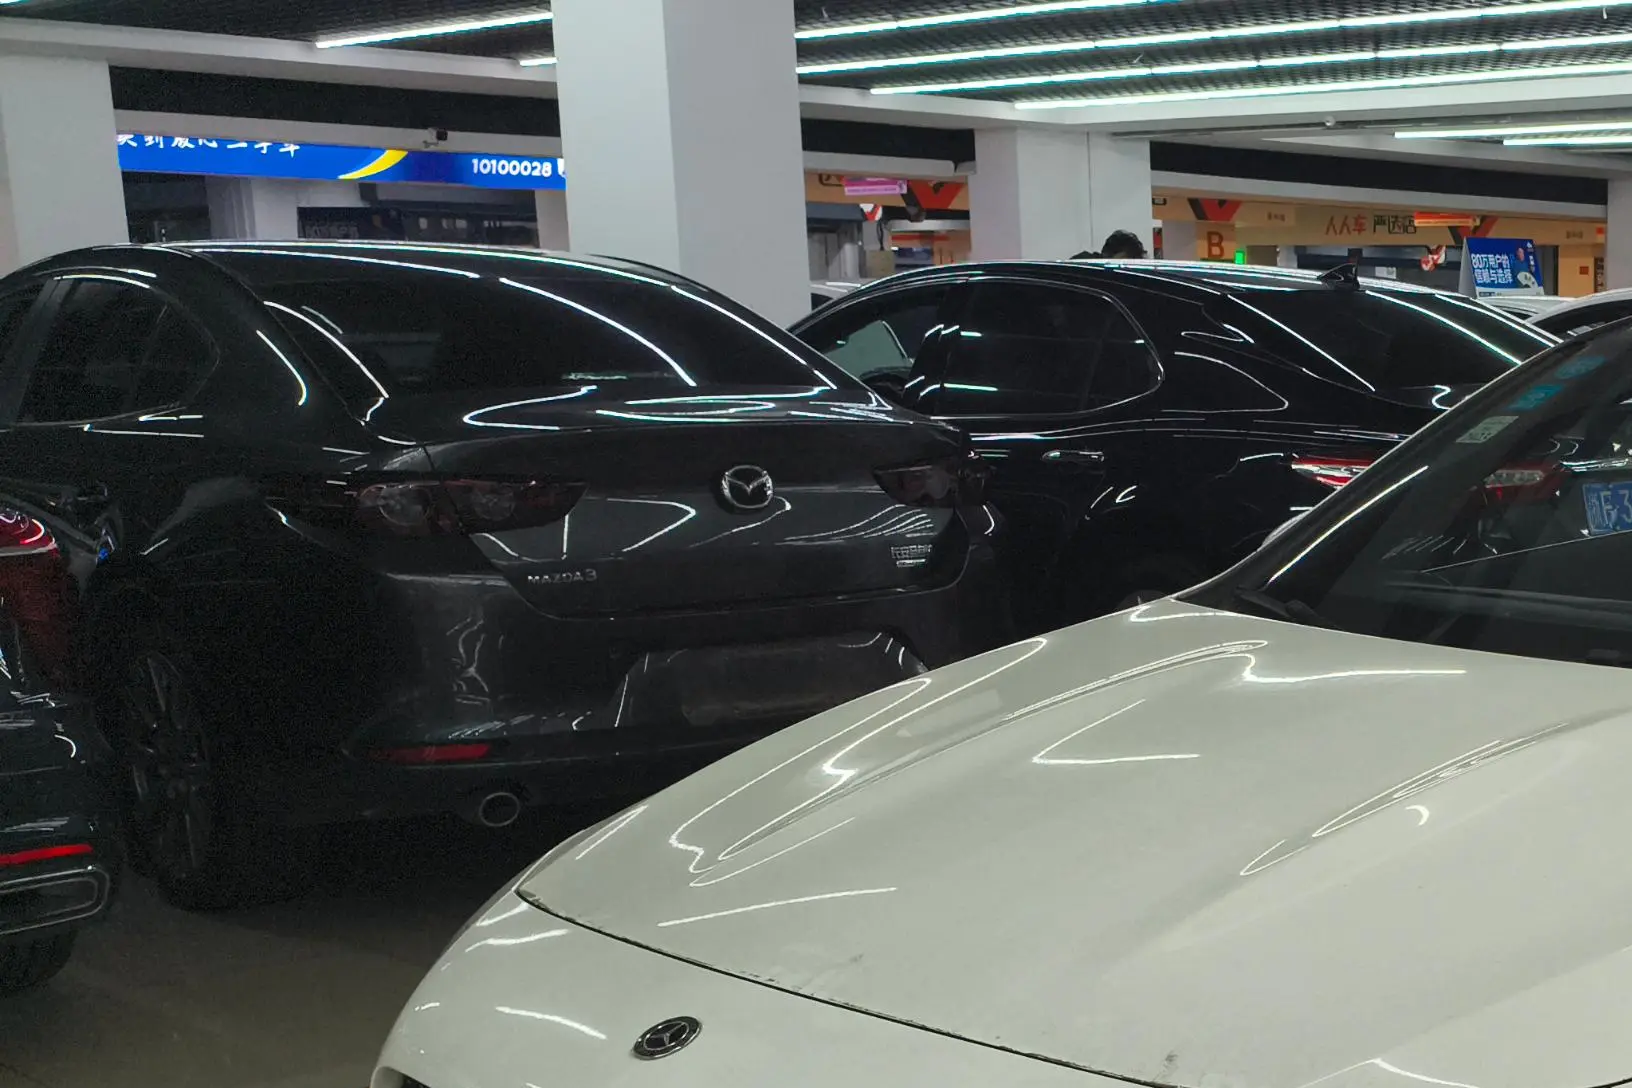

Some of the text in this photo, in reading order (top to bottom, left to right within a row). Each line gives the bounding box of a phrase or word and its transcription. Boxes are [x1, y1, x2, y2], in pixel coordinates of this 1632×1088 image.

[471, 158, 553, 178] 10100028
[1325, 214, 1367, 236] 人人车
[1206, 231, 1225, 259] B
